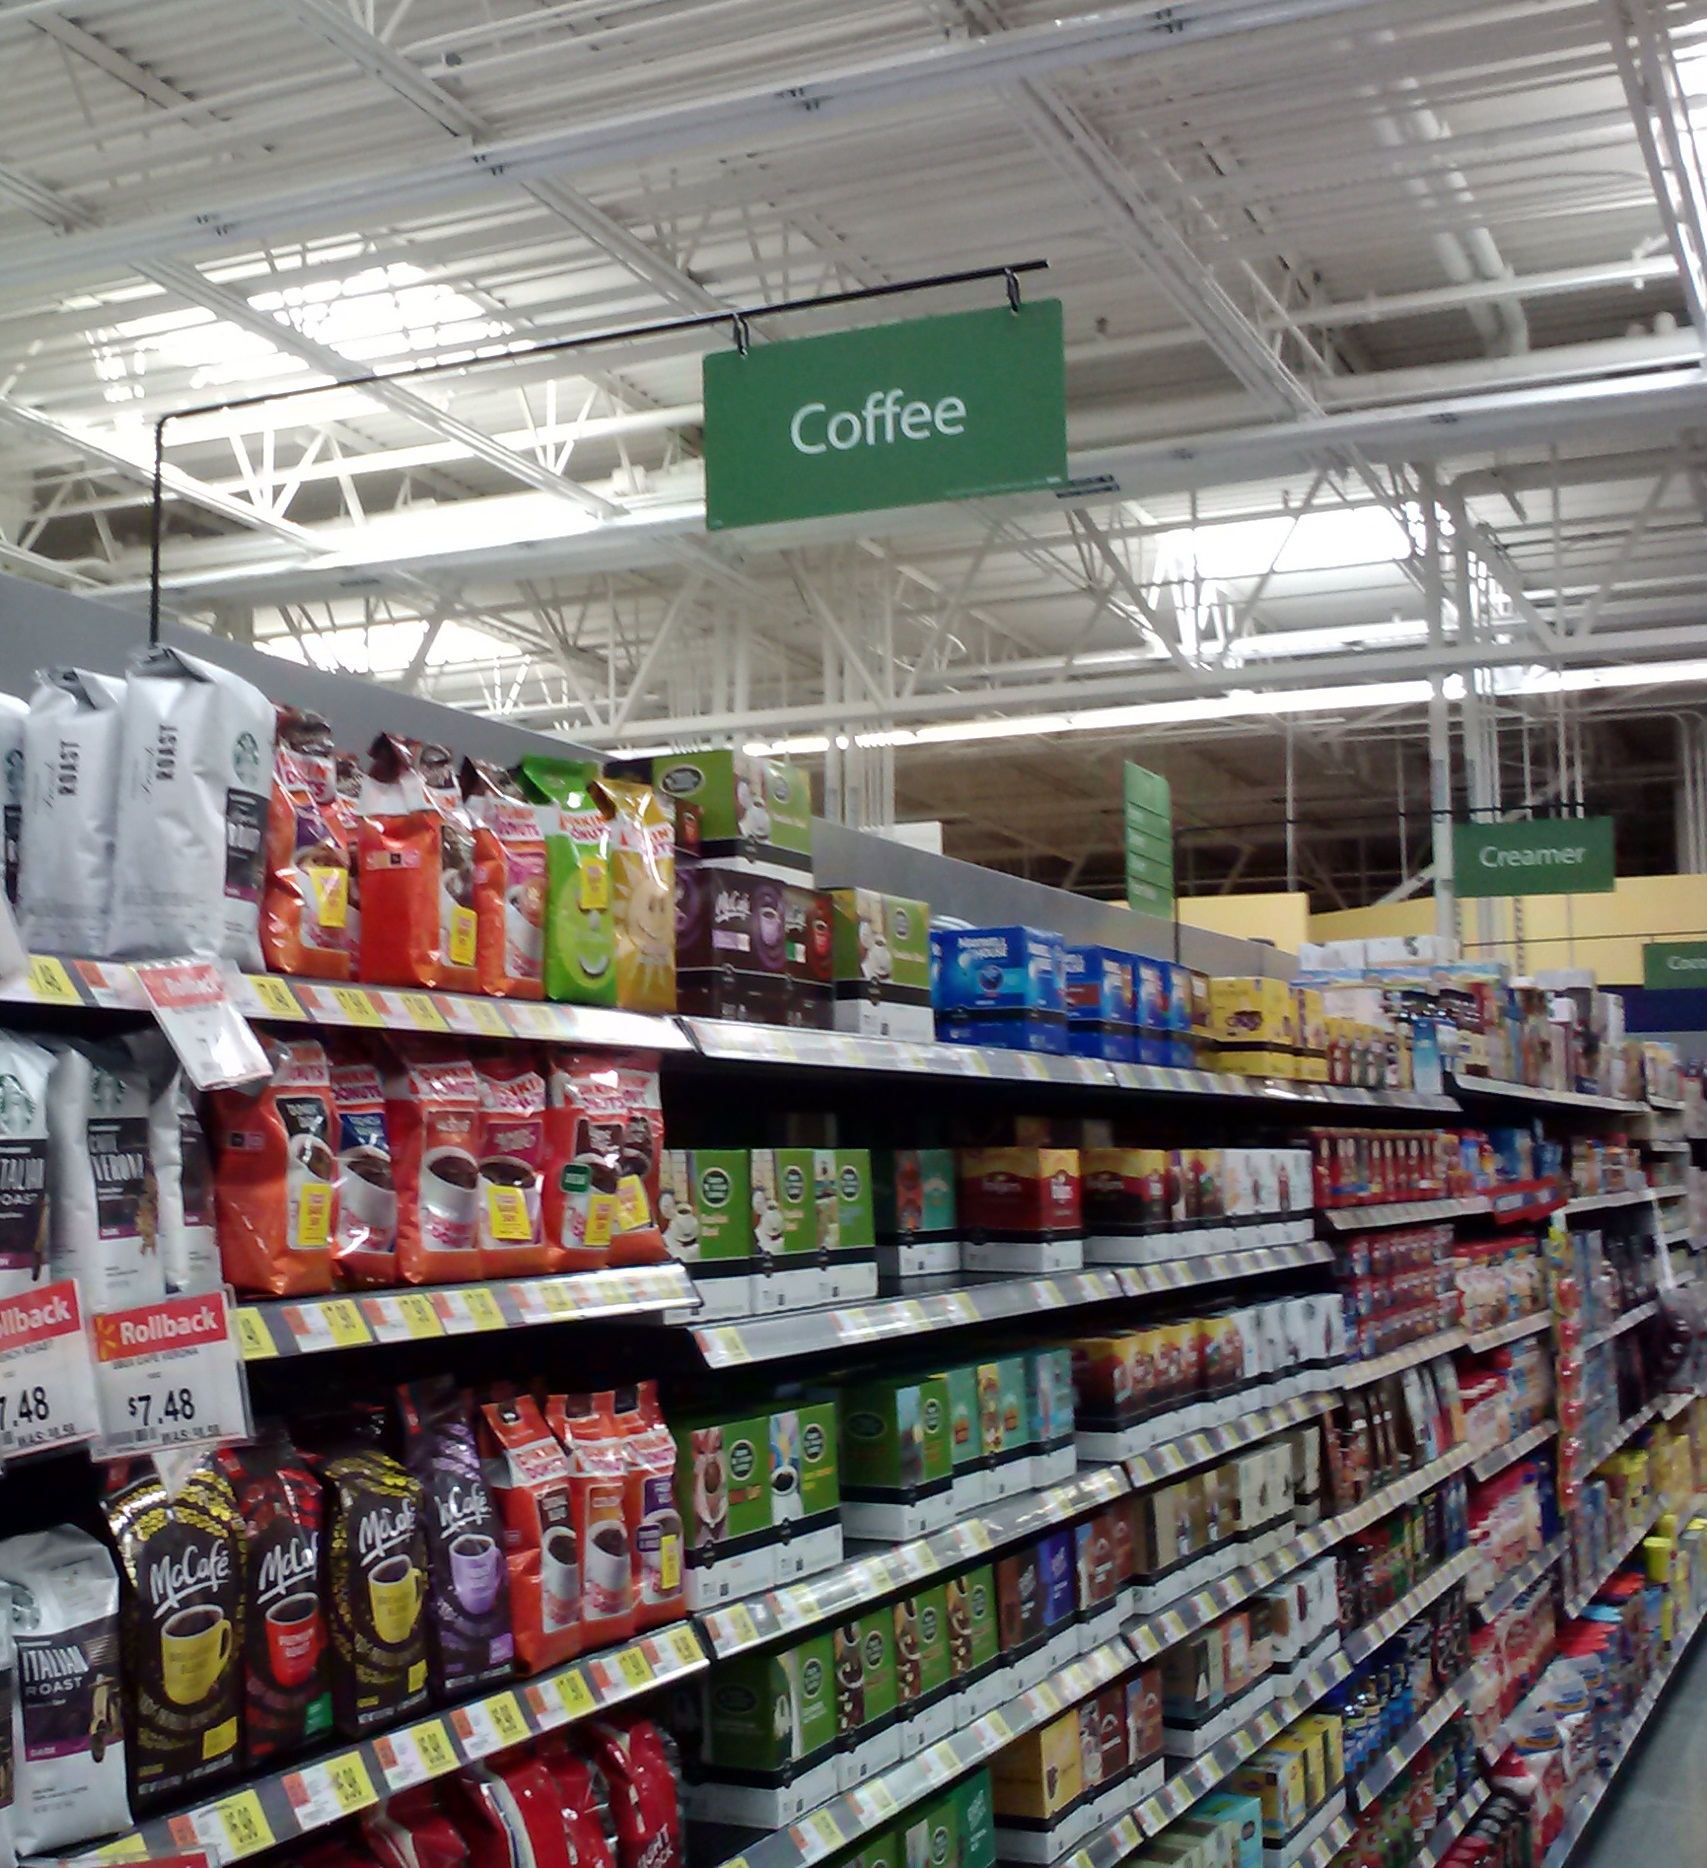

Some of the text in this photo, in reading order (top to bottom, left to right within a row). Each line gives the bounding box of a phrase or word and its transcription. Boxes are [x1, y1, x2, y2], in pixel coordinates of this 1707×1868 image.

[790, 388, 967, 455] Coffee
[1479, 845, 1586, 868] Creamer
[0, 1192, 39, 1206] OAST
[120, 1306, 219, 1346] Rollback
[0, 1386, 50, 1432] 7.48
[128, 1387, 196, 1427] $7.48
[150, 1538, 232, 1609] McCafé
[257, 1530, 319, 1596] McCaf
[22, 1646, 90, 1683] ITALIAN
[25, 1676, 84, 1697] ROAST
